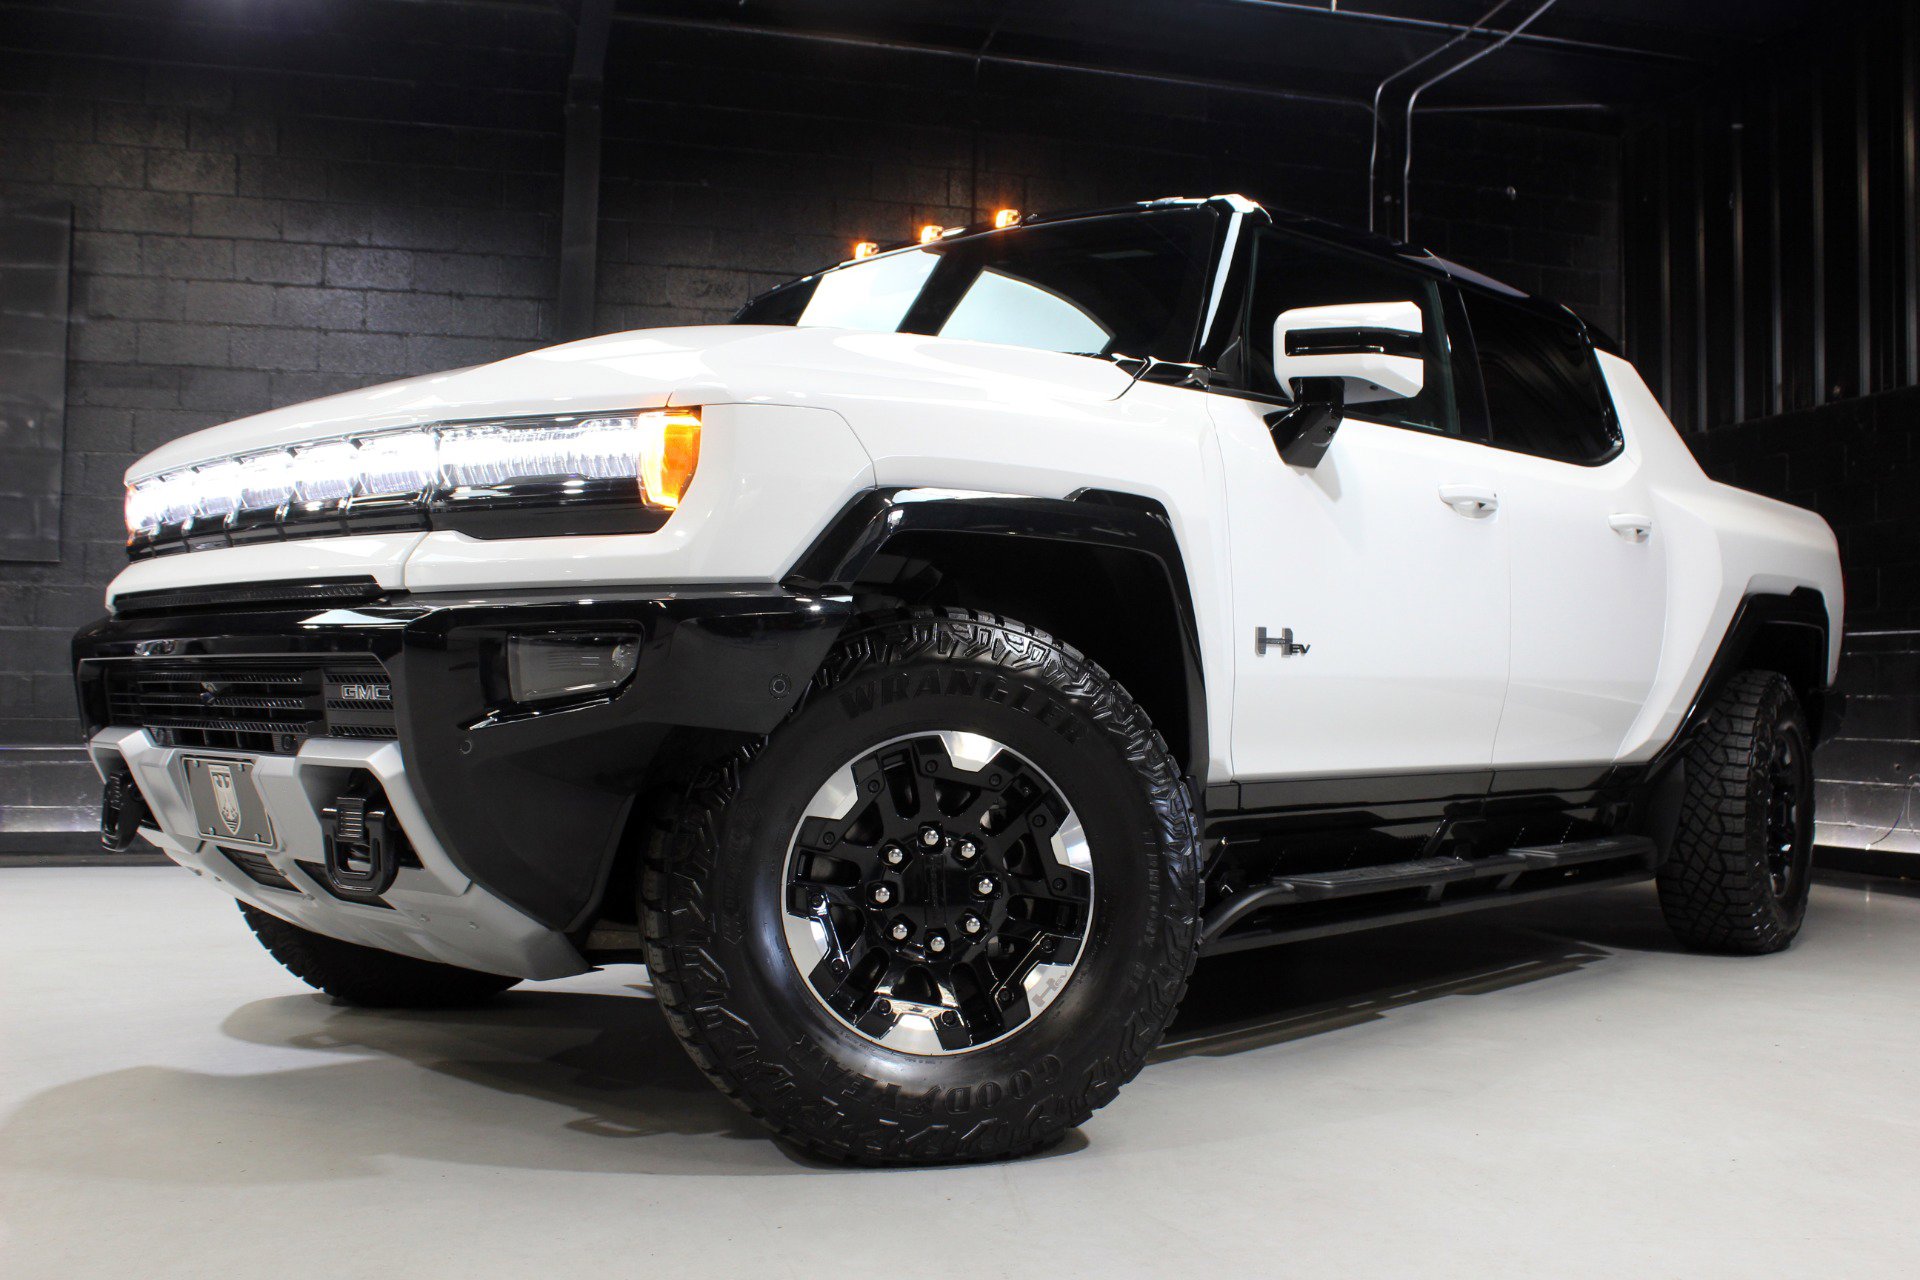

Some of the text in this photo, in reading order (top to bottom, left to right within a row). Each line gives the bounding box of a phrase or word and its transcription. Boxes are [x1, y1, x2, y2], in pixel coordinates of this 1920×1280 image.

[341, 684, 390, 700] GMC
[839, 667, 1087, 744] WRANGLER
[785, 1033, 1063, 1116] GOODYEAR
